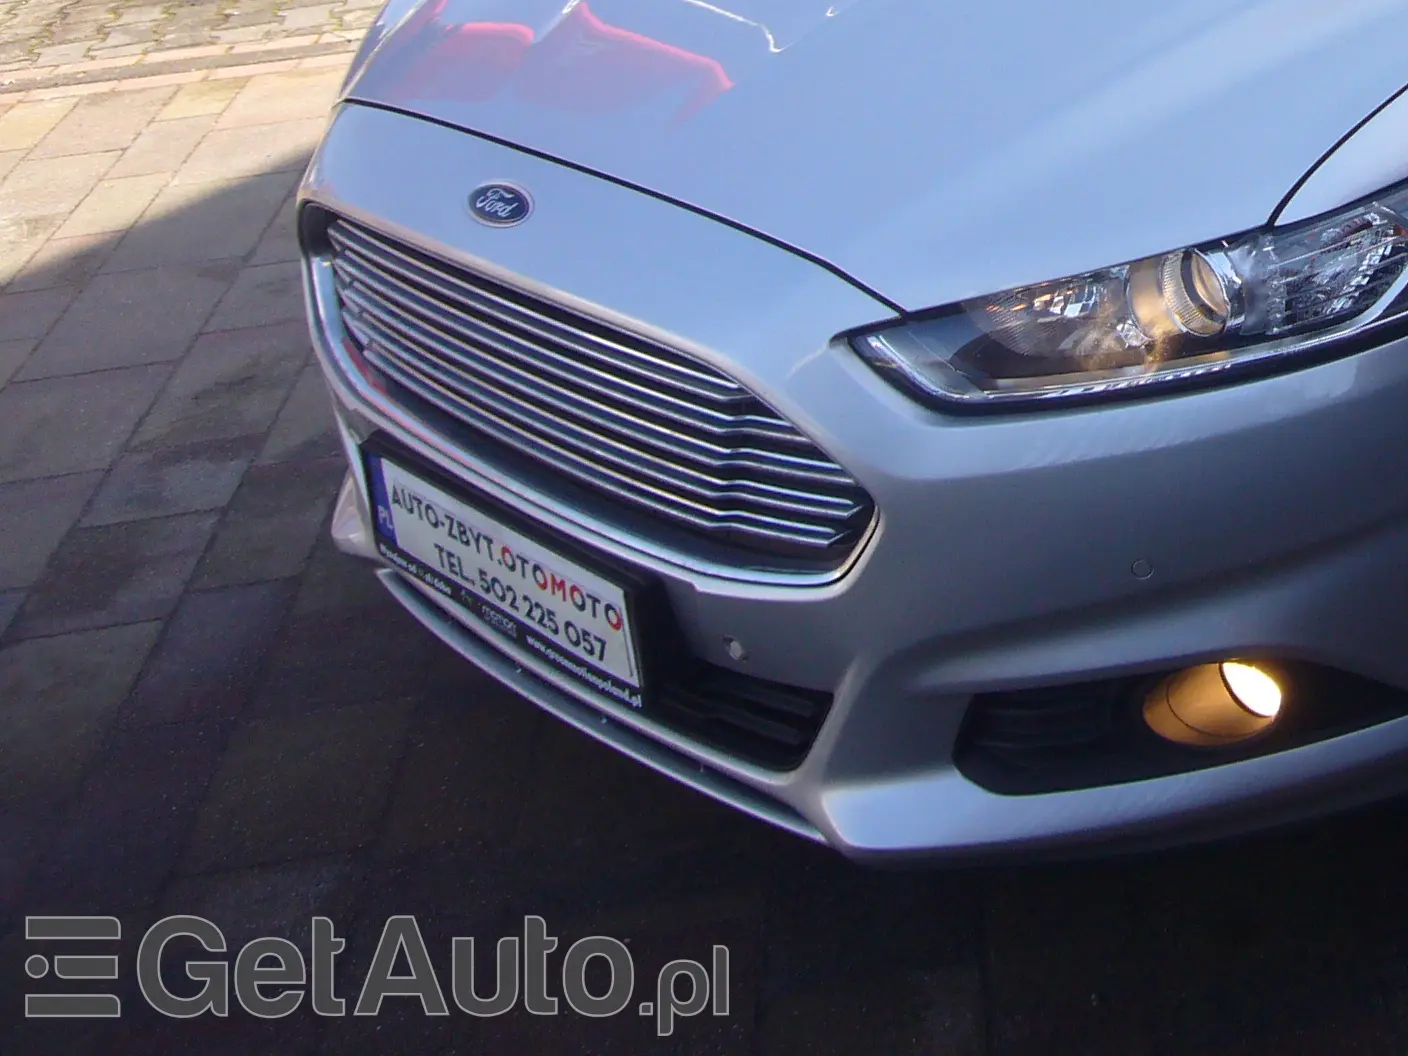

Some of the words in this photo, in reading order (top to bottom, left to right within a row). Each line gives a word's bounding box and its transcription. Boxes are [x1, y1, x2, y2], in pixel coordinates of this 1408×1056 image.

[476, 188, 519, 217] Ford
[377, 505, 394, 530] PL
[478, 567, 519, 612] 502
[522, 596, 559, 635] 225
[564, 620, 607, 662] 057
